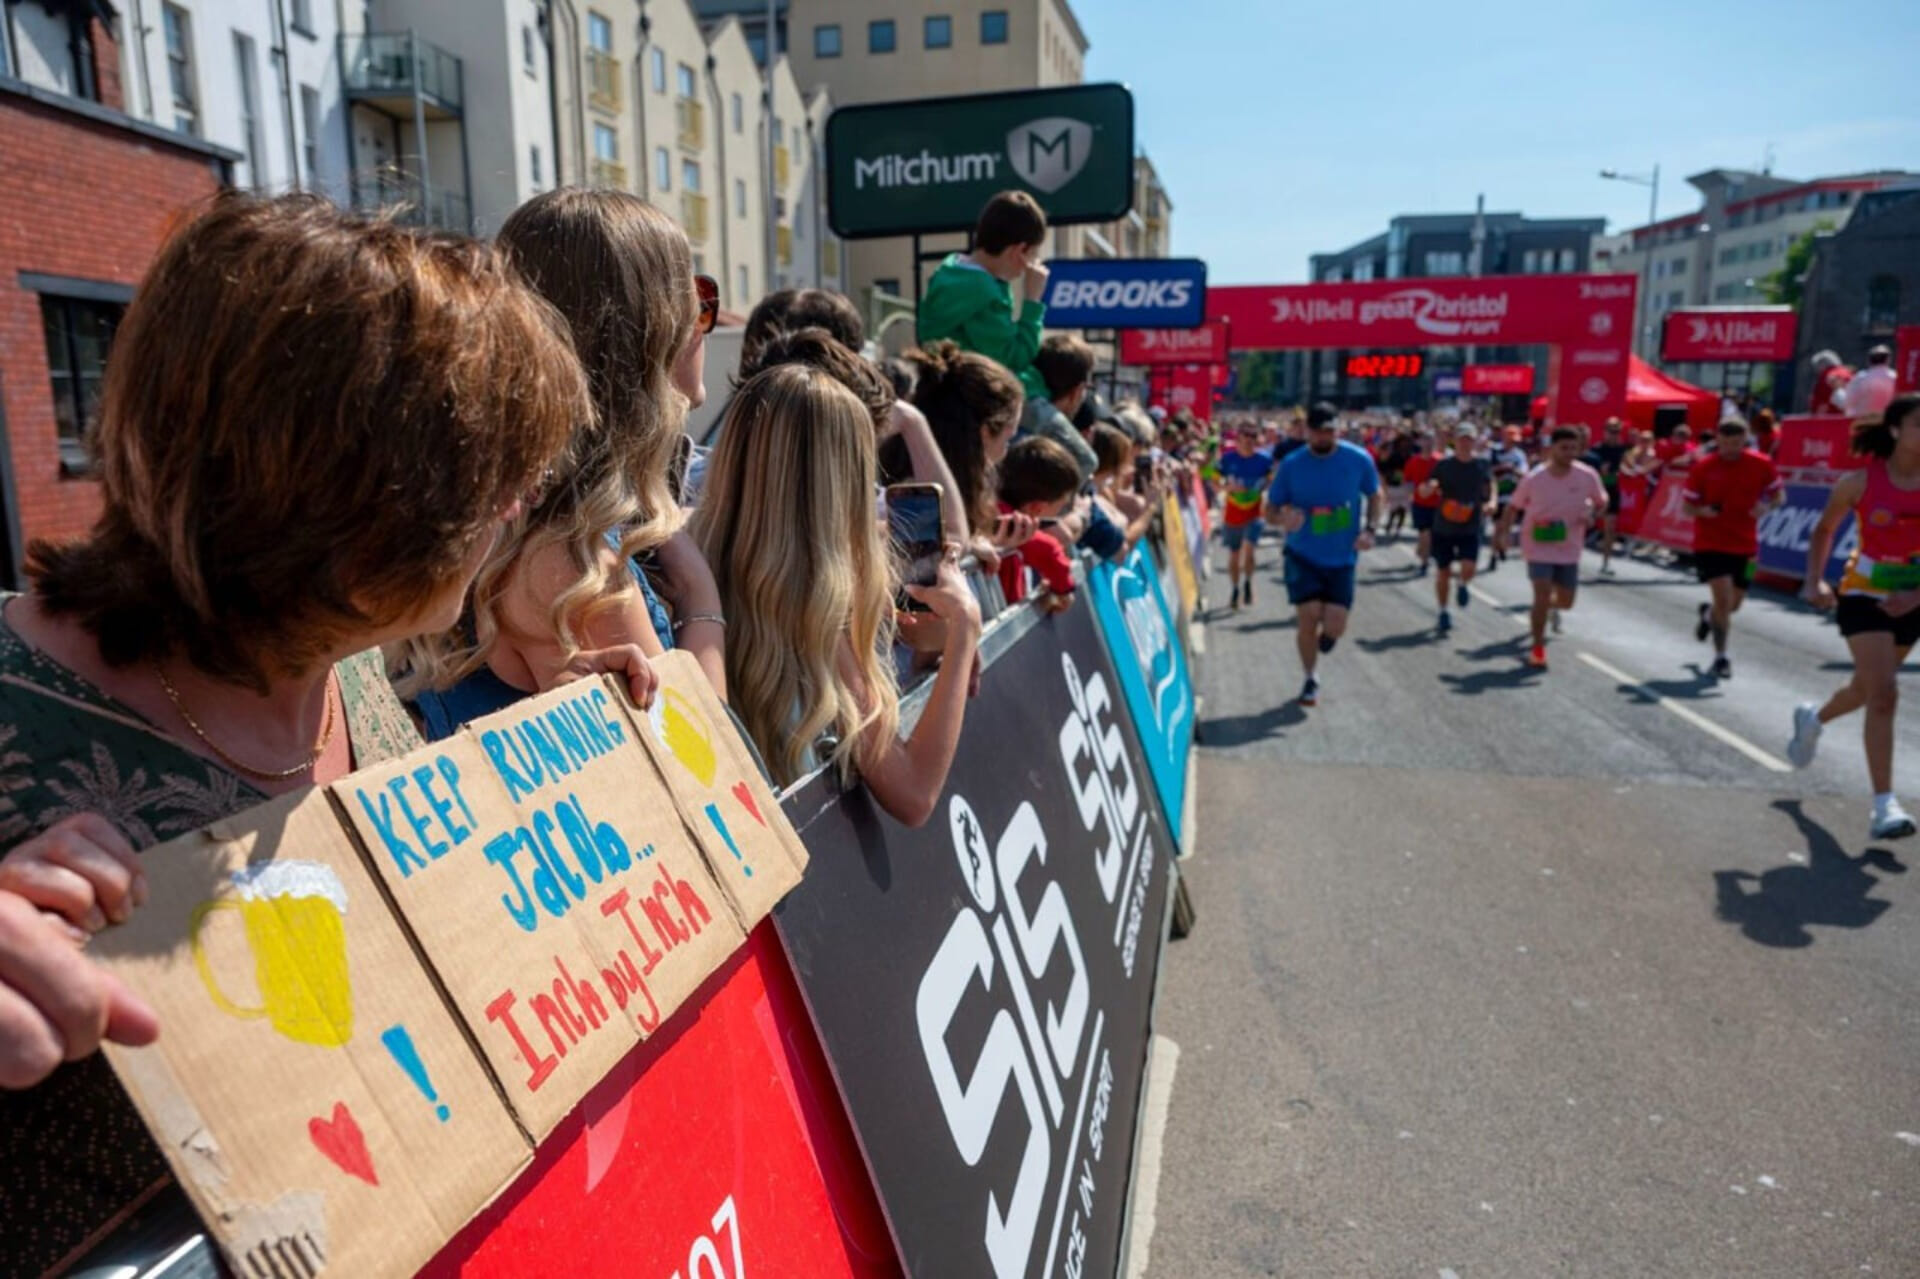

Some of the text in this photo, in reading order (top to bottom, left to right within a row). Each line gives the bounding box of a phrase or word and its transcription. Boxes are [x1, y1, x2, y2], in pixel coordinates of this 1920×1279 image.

[854, 149, 996, 190] Mitchum
[1049, 278, 1194, 309] BROOKS
[1434, 291, 1509, 320] bristol
[356, 688, 628, 879] KEEP RUNNING
[484, 954, 609, 1094] Inch
[600, 861, 713, 977] Inch
[1089, 1049, 1114, 1162] SPORT
